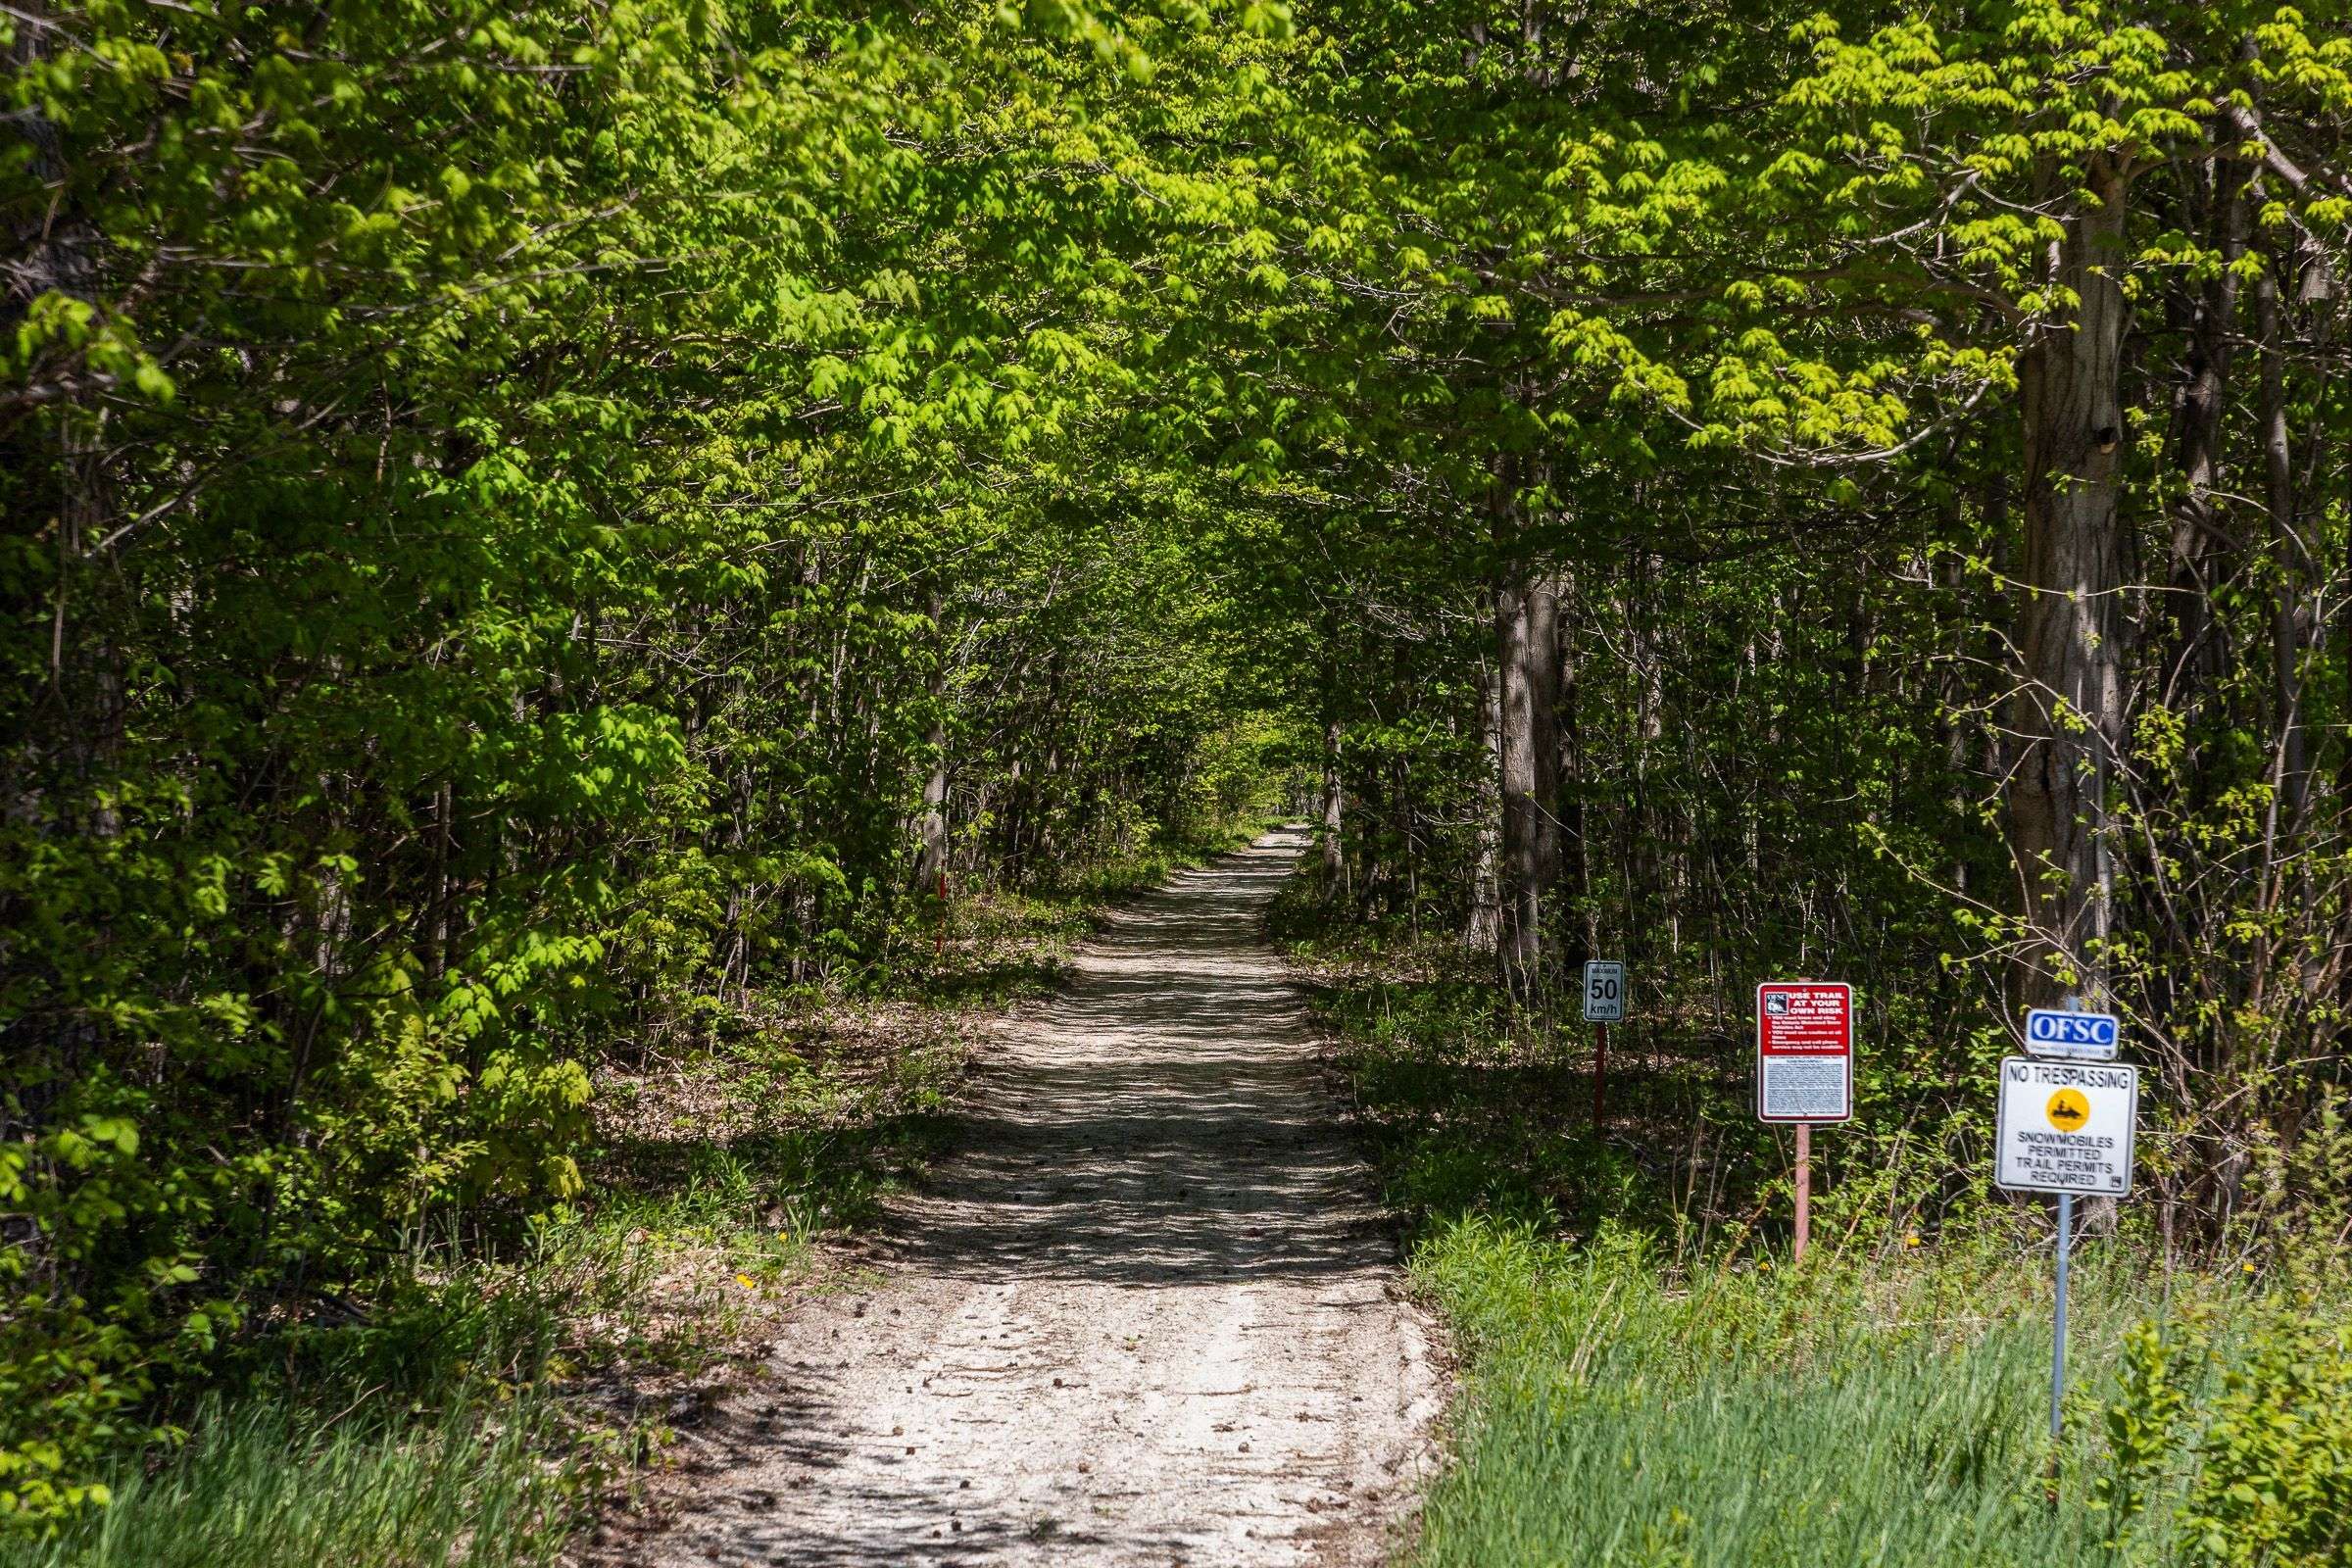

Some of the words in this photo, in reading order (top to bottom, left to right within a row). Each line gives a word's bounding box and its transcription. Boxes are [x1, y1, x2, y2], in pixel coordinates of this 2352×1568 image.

[1591, 979, 1617, 1000] 50
[1591, 1004, 1617, 1014] km/h
[2034, 1016, 2113, 1044] OFSC
[2010, 1065, 2029, 1082] NO
[2034, 1066, 2128, 1089] TRESPASSING
[2017, 1131, 2114, 1149] SNOWMOBILES
[2028, 1145, 2102, 1160] PERMITTED
[2015, 1157, 2053, 1170] TRAIL
[2057, 1160, 2114, 1174] PERMITS
[2031, 1171, 2096, 1186] REQUIRED
